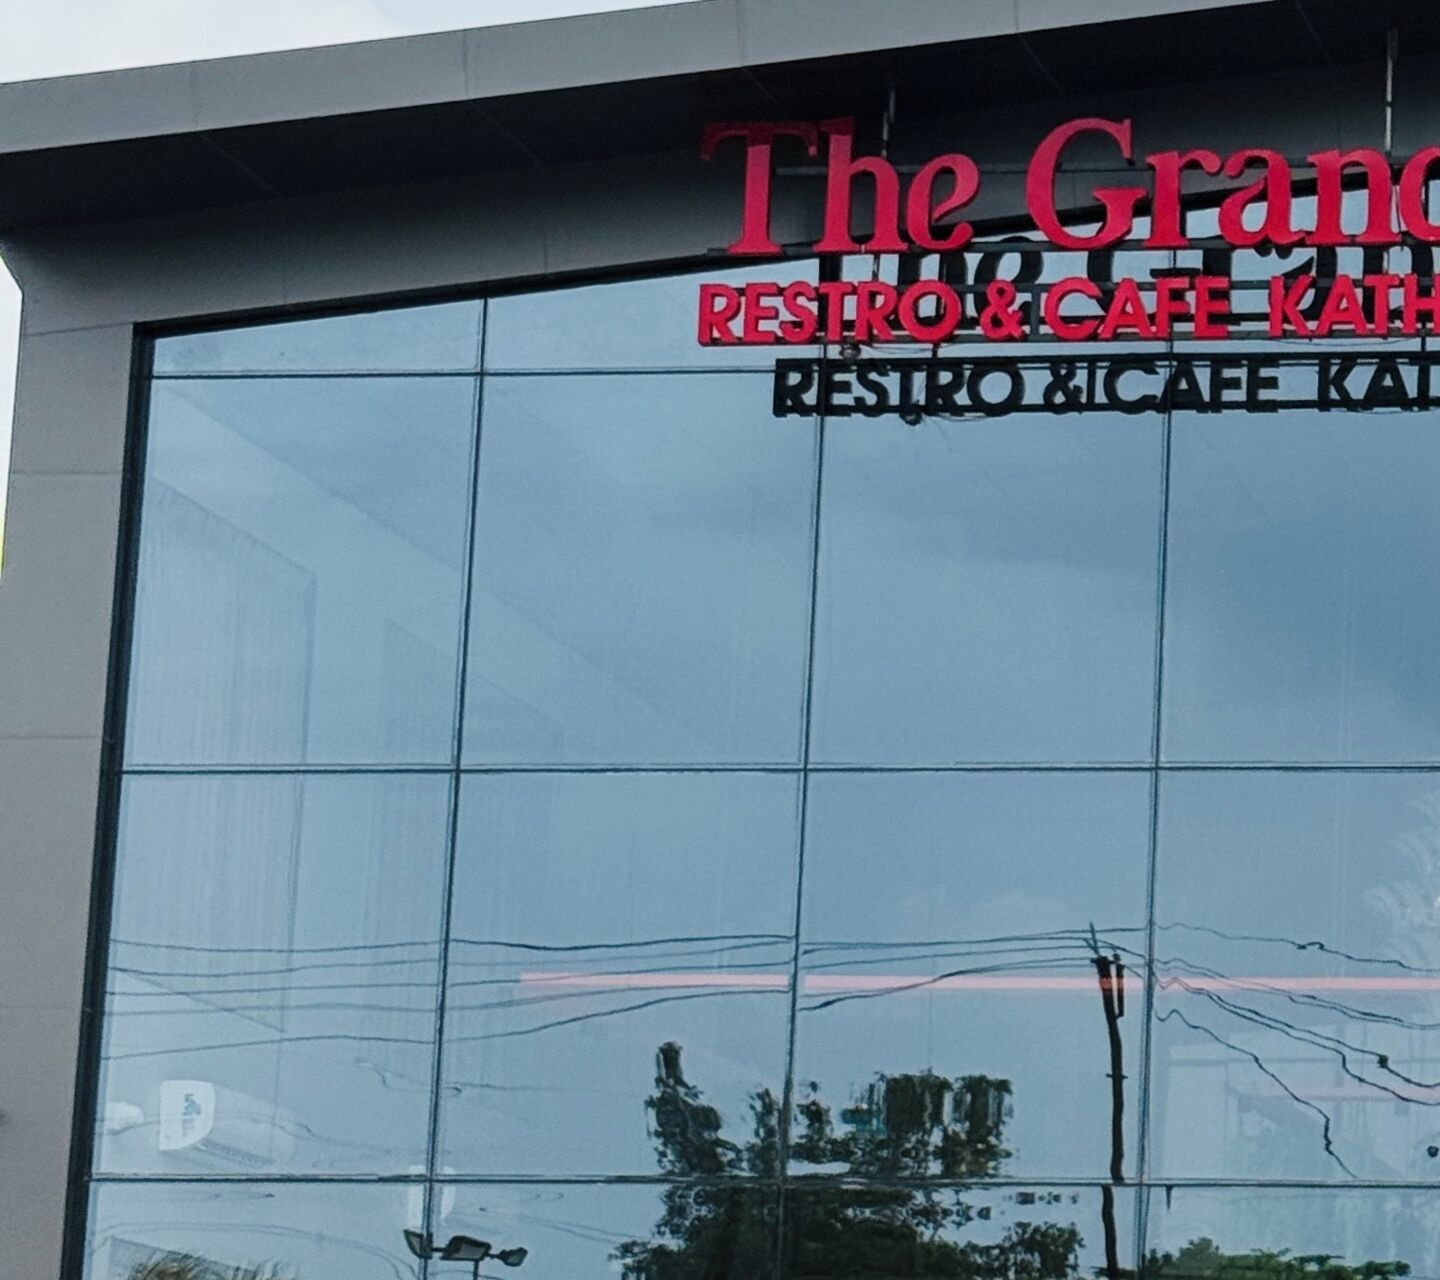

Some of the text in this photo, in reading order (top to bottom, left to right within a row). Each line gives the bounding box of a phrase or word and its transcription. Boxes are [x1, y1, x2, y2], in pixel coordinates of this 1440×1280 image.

[700, 117, 981, 256] The
[697, 278, 963, 346] RESTRO
[979, 276, 1026, 342] &
[1042, 274, 1231, 342] CAFE
[1103, 358, 1280, 413] CAFE
